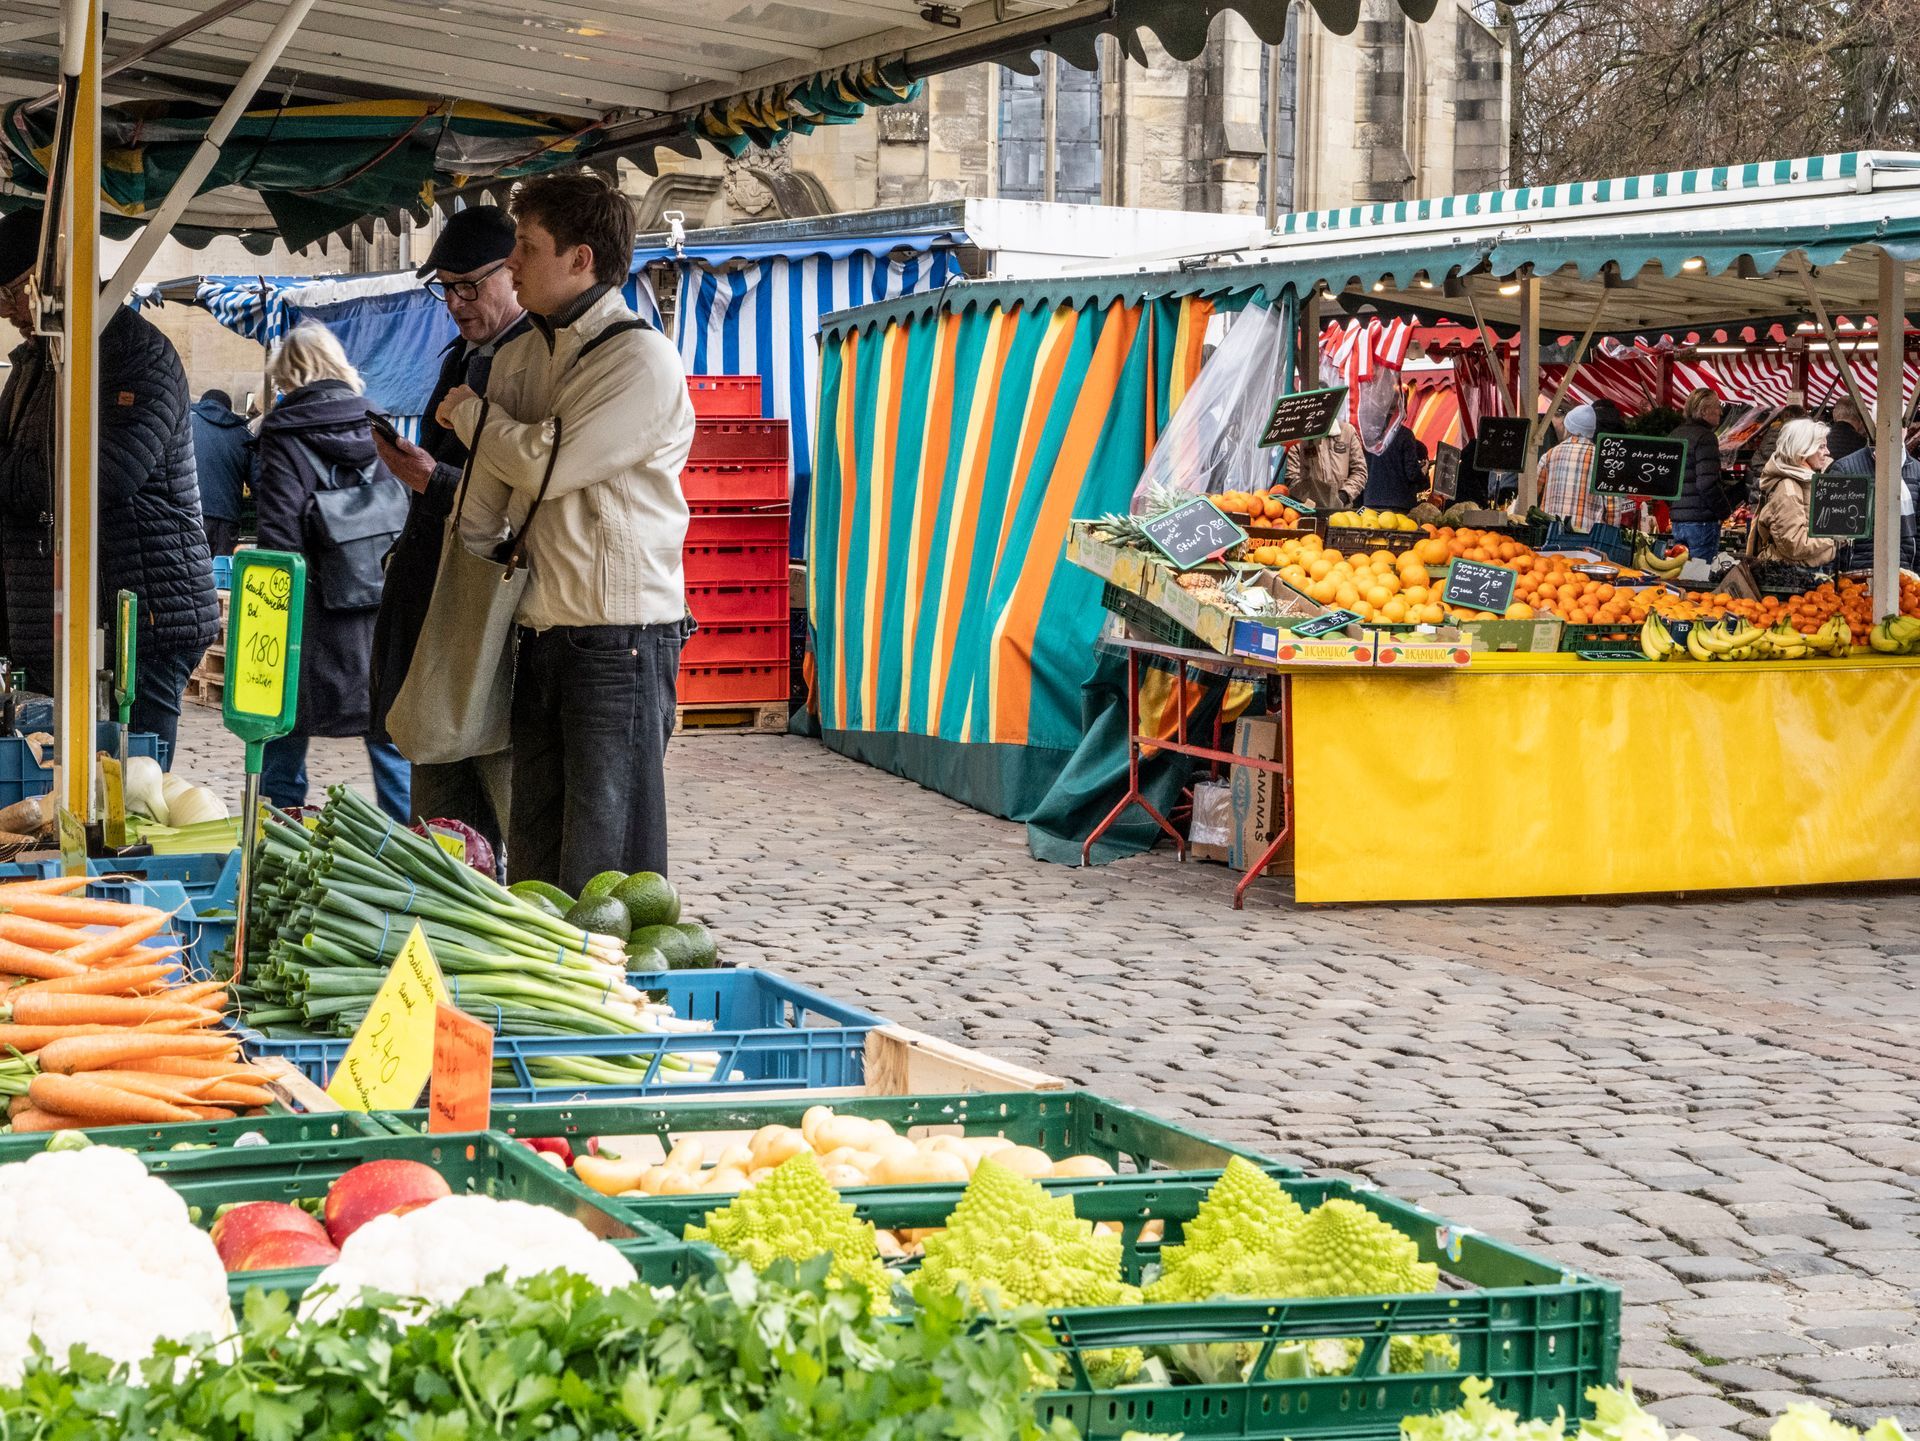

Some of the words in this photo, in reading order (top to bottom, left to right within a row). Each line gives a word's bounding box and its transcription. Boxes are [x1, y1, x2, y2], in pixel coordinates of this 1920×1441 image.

[1274, 417, 1284, 426] 5
[1265, 429, 1279, 439] 10
[1631, 451, 1654, 459] ohne
[1603, 458, 1625, 470] 500
[1816, 506, 1831, 529] 10
[1151, 518, 1174, 533] Costa
[1449, 586, 1460, 599] 5
